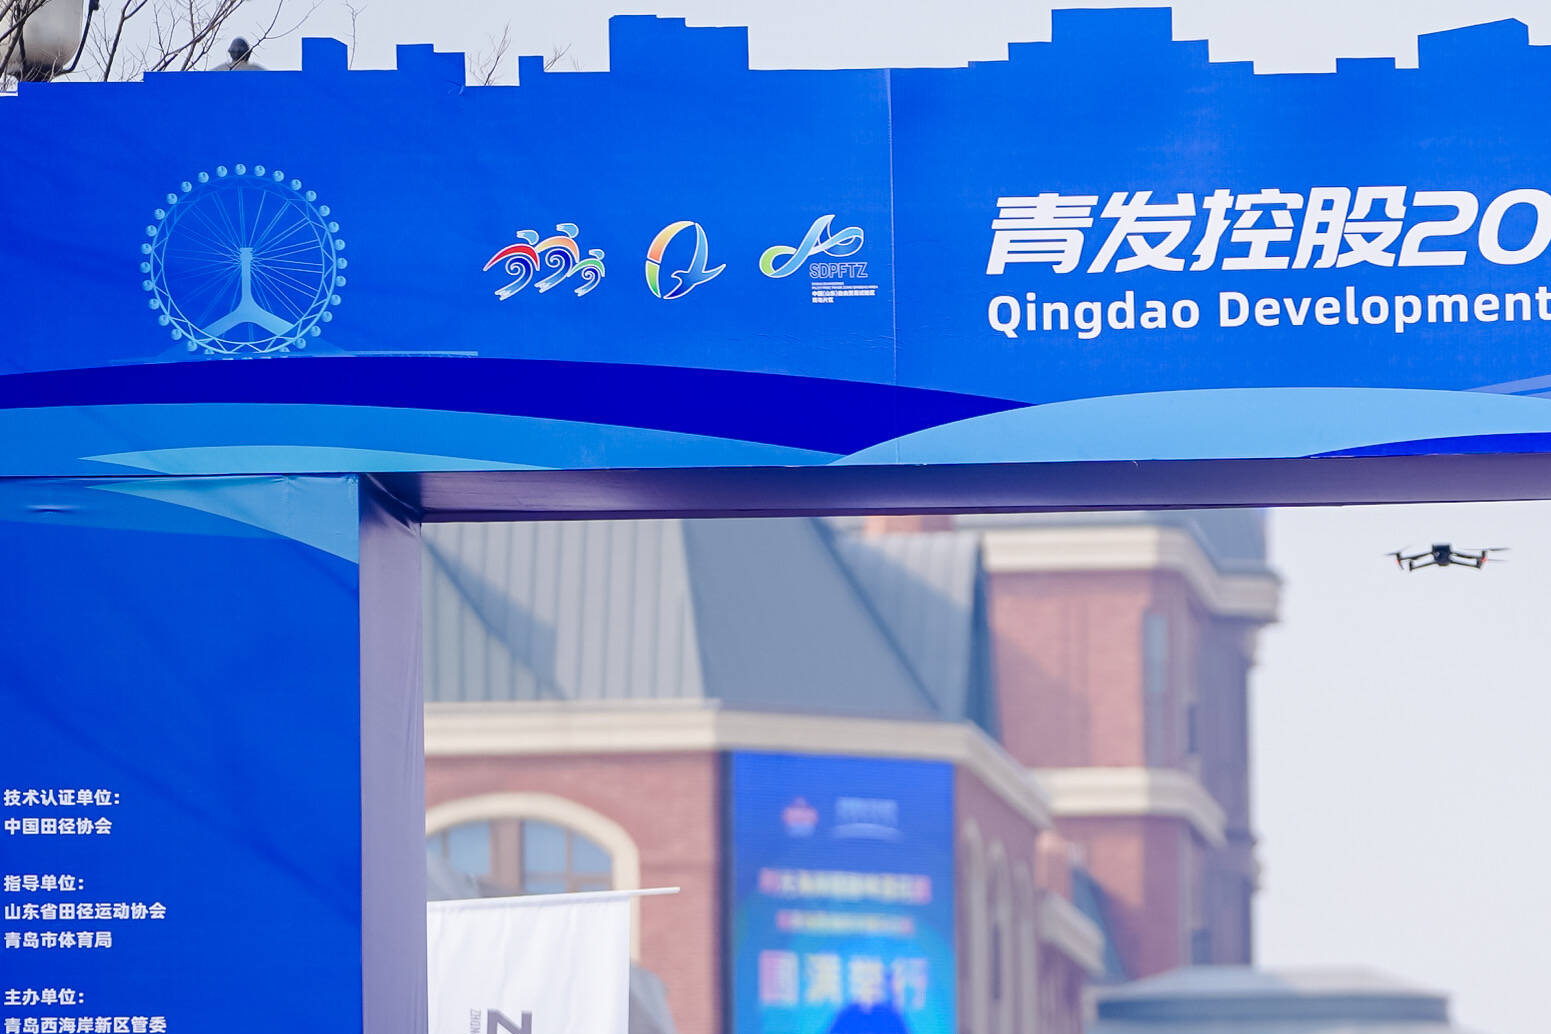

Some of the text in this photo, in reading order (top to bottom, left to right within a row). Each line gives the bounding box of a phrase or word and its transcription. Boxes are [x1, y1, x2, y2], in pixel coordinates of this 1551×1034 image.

[809, 262, 868, 279] SDPFTZ
[988, 290, 1199, 339] Qingdao
[4, 789, 119, 806] 技术认证单位：
[4, 817, 112, 835] 中国田径协会
[4, 874, 84, 891] 指导单位：
[4, 902, 167, 921] 山东省田径运动协会
[4, 931, 112, 949] 青岛市体育局
[4, 988, 84, 1006] 主办单位：
[4, 1016, 167, 1034] 青岛西海岸新区管委
